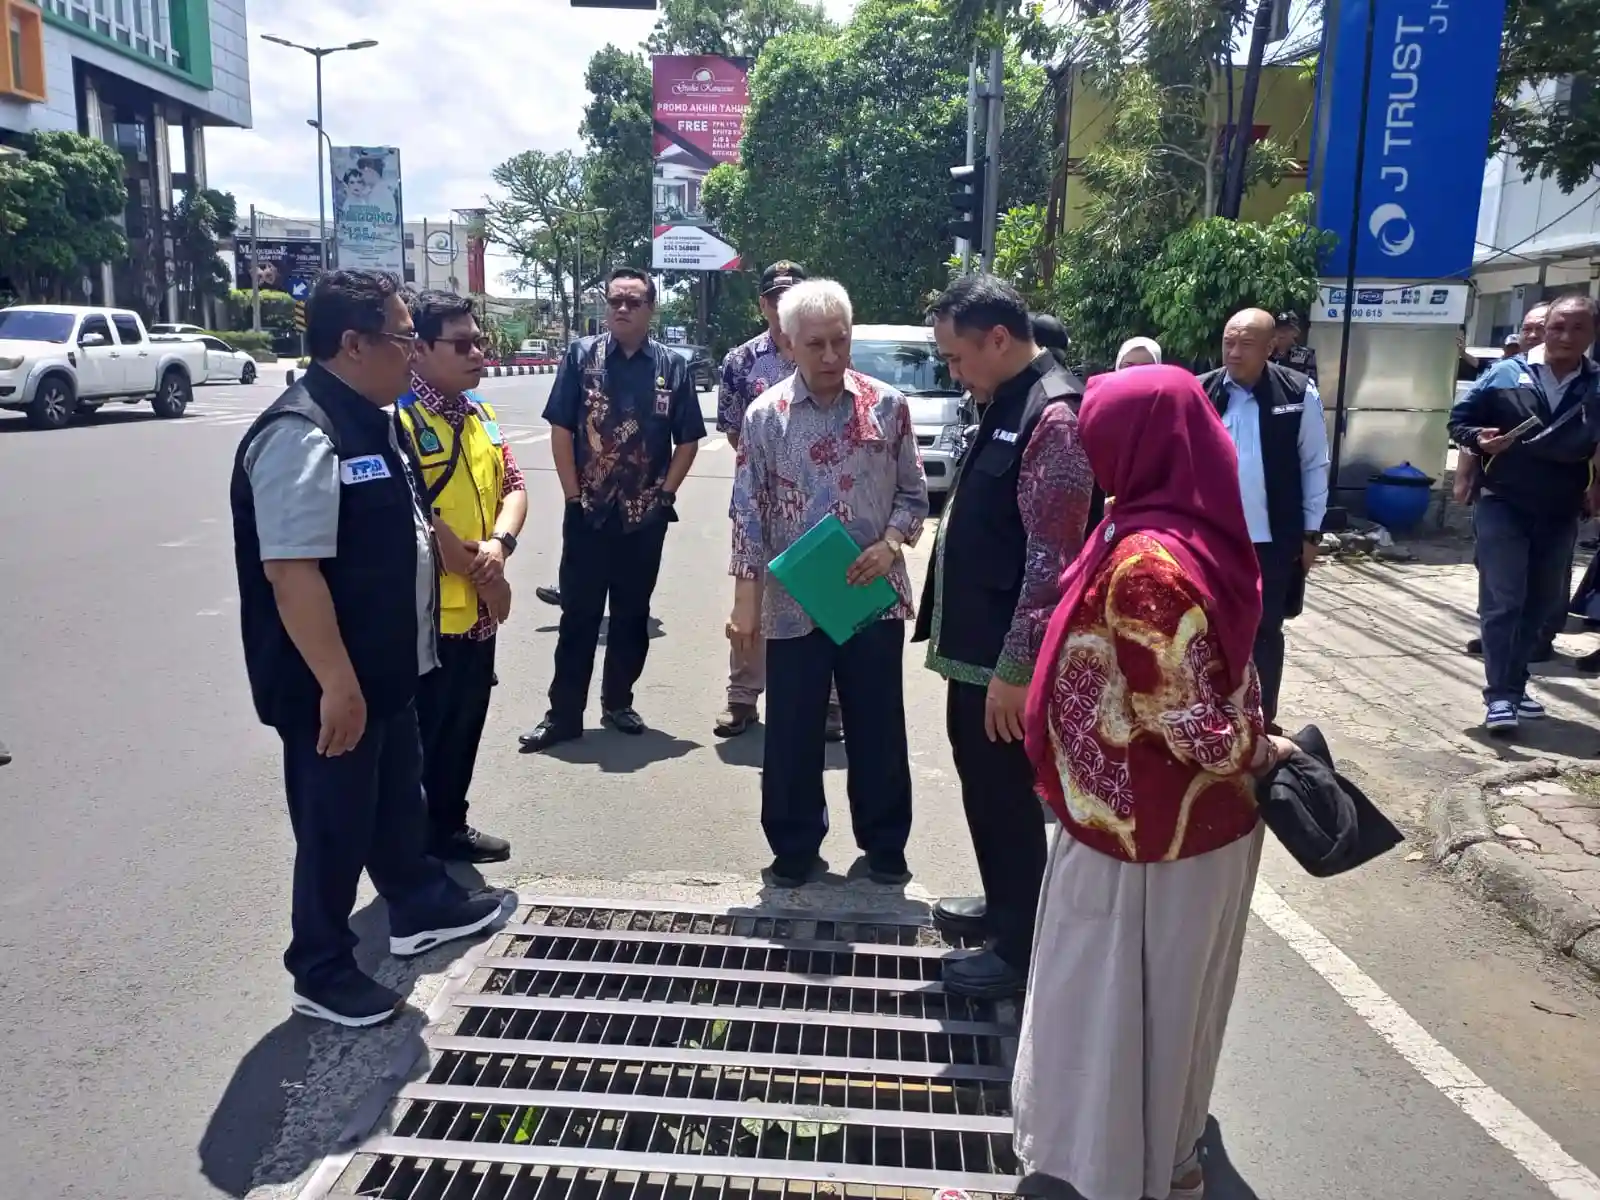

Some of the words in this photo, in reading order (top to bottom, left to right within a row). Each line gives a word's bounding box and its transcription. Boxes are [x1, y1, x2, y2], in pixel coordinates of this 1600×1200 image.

[1383, 15, 1425, 156] TRUST
[657, 102, 688, 112] PROMO
[689, 103, 718, 113] AKHIR
[677, 120, 709, 132] FREE
[1380, 166, 1409, 192] J
[1341, 309, 1363, 317] 100
[1366, 309, 1383, 318] 615
